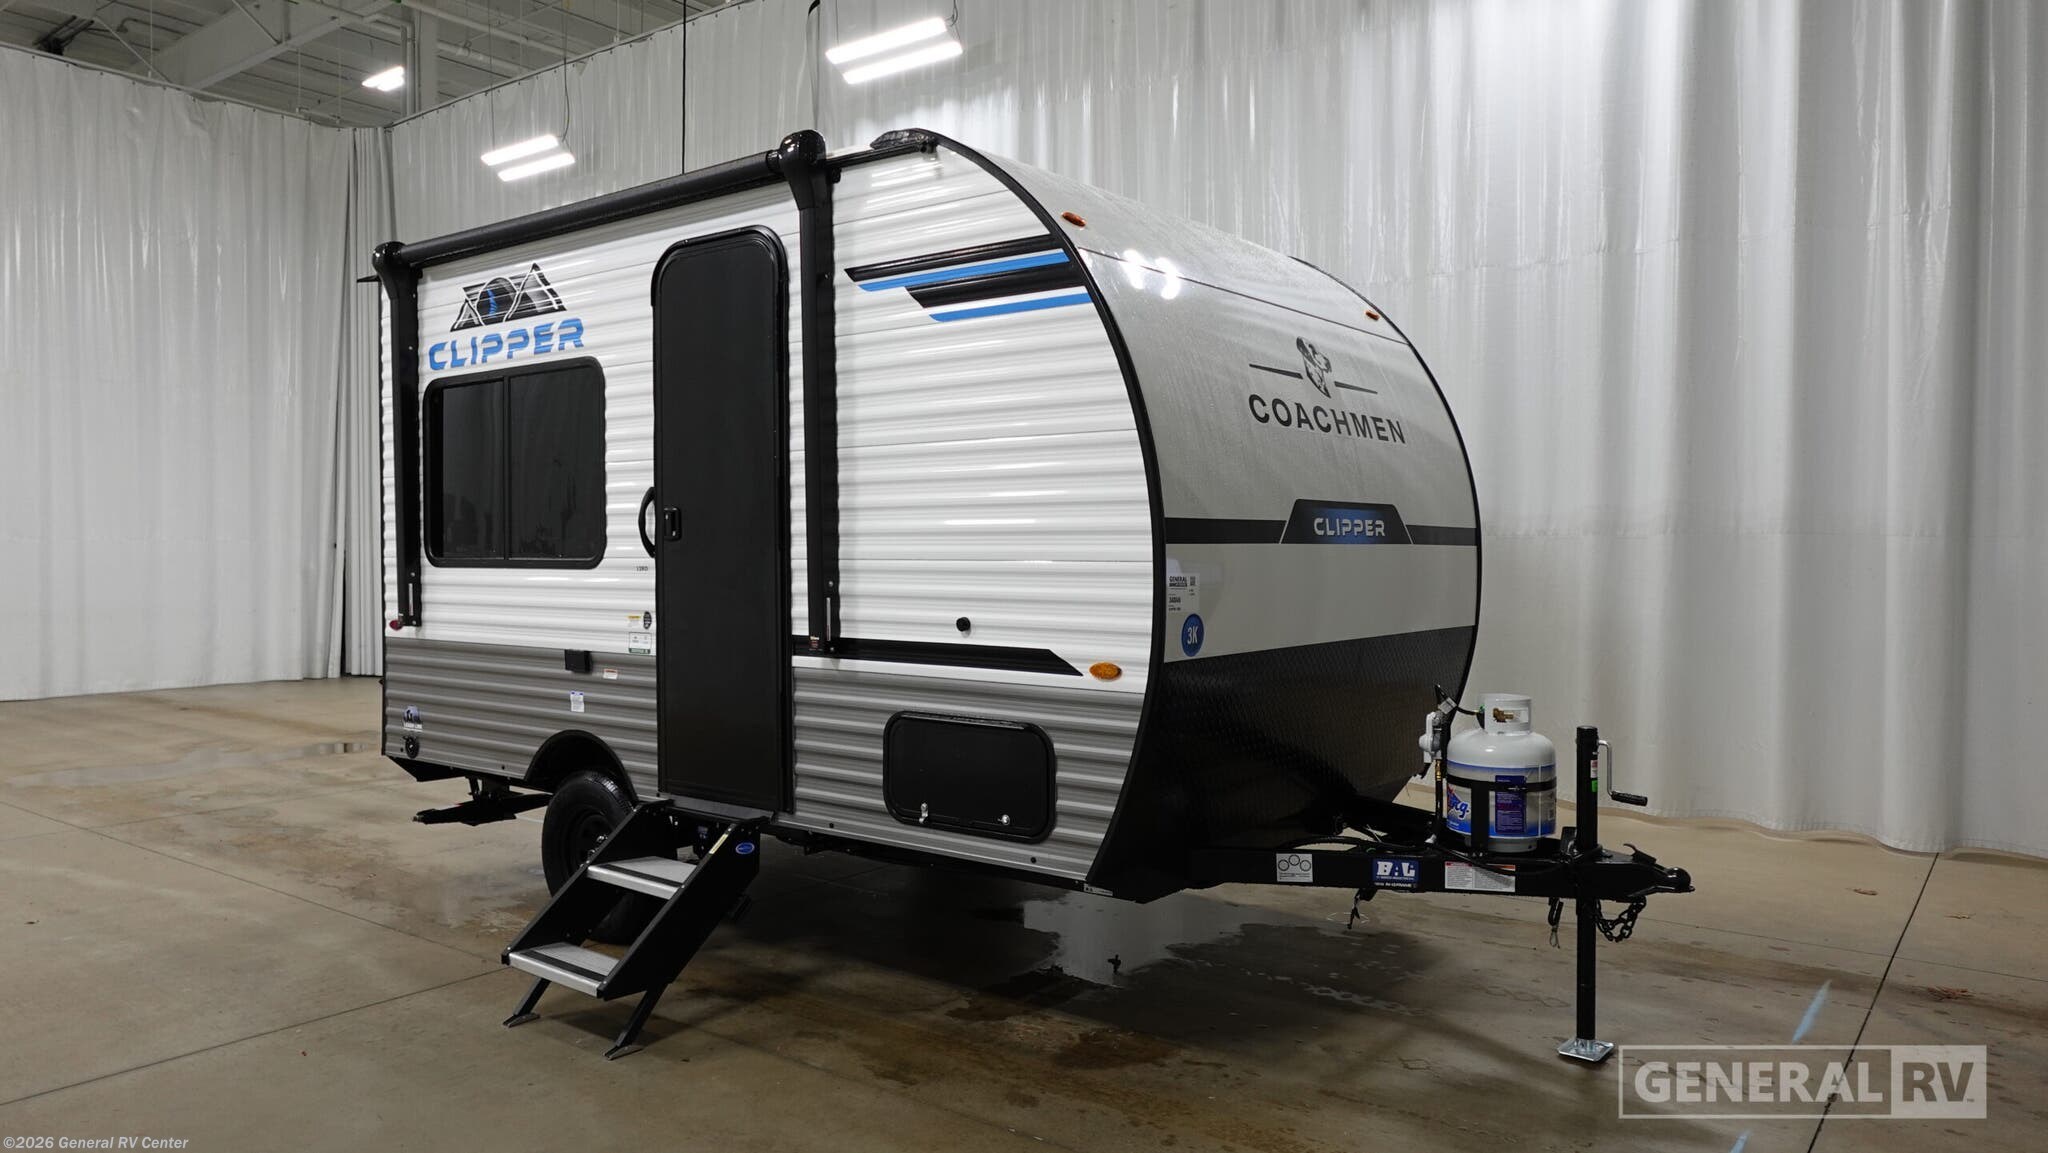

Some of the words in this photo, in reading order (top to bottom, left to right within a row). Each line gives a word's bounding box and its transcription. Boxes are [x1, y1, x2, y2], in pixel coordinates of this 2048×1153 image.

[428, 318, 584, 370] CLIPPER
[1249, 394, 1406, 444] COACHMEN
[1313, 517, 1385, 537] CLIPPER
[1187, 626, 1198, 644] 3K
